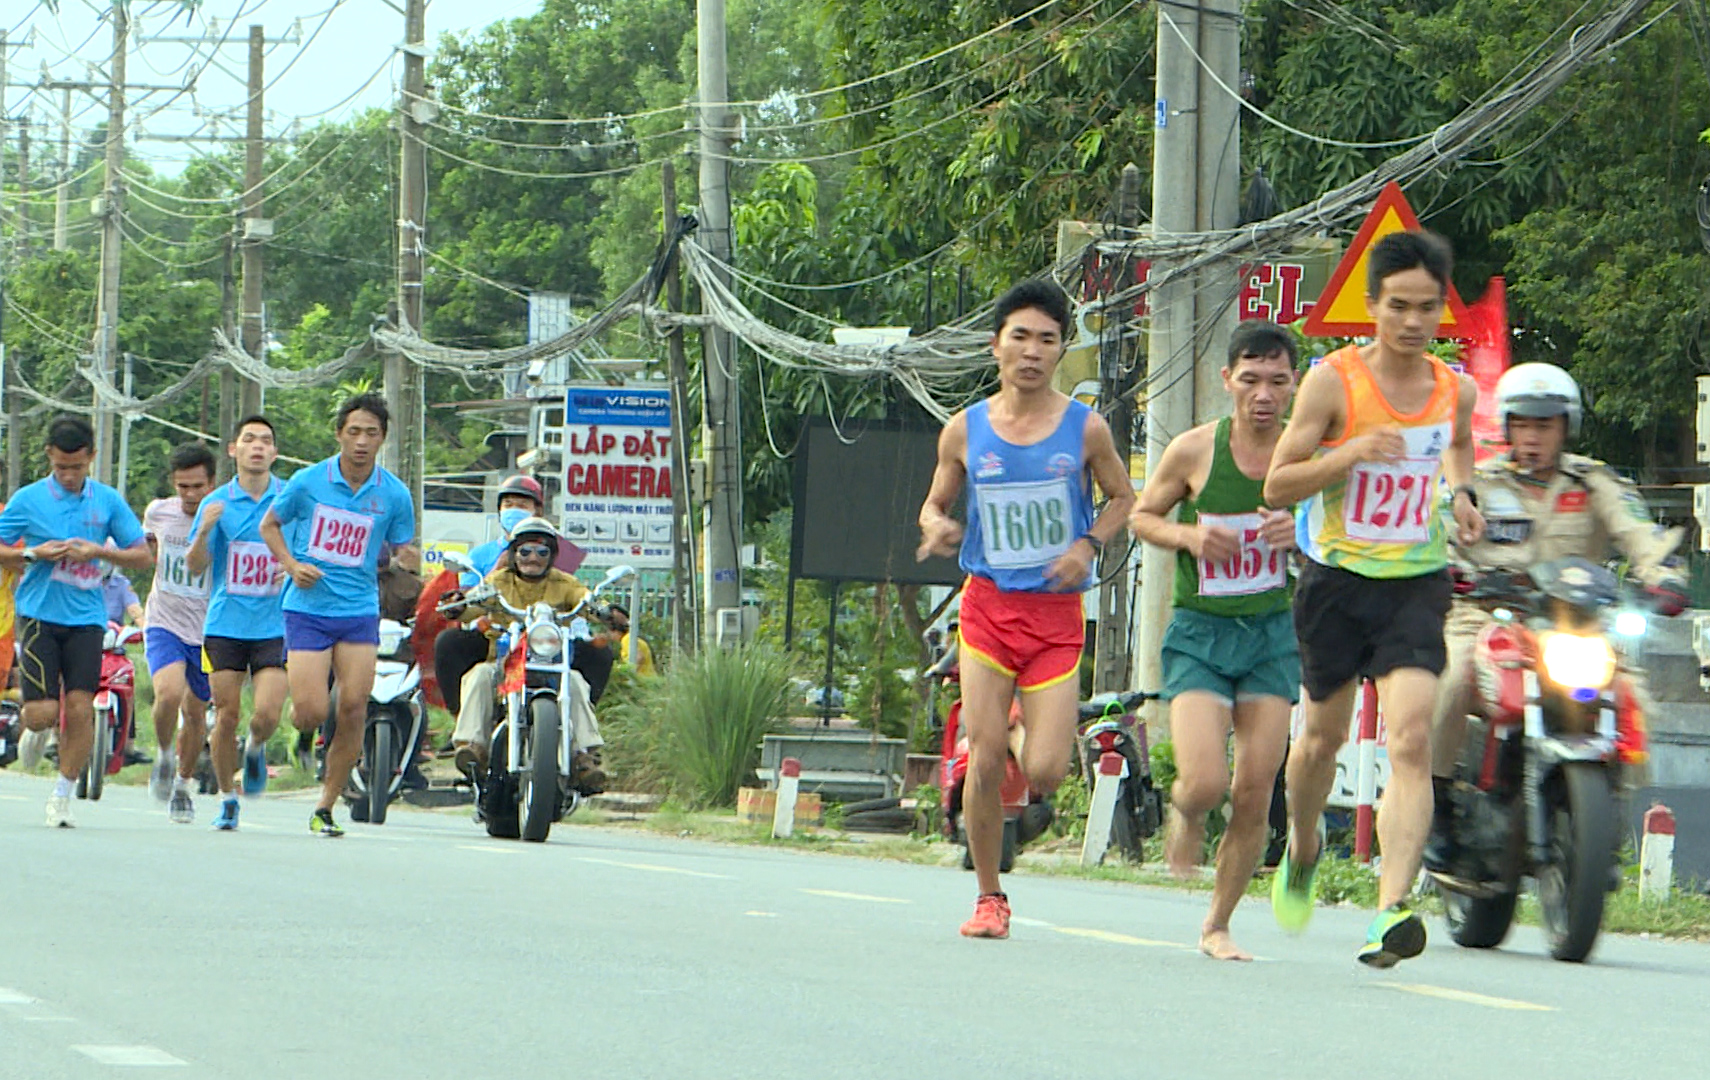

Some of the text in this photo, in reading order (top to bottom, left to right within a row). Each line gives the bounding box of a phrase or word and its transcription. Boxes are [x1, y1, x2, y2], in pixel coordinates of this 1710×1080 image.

[571, 425, 671, 462] LẮP ĐẶT
[567, 463, 672, 498] CAMERA
[1351, 471, 1430, 529] 1271
[313, 516, 367, 557] 1288
[986, 498, 1064, 551] 1608
[232, 551, 279, 585] 1287
